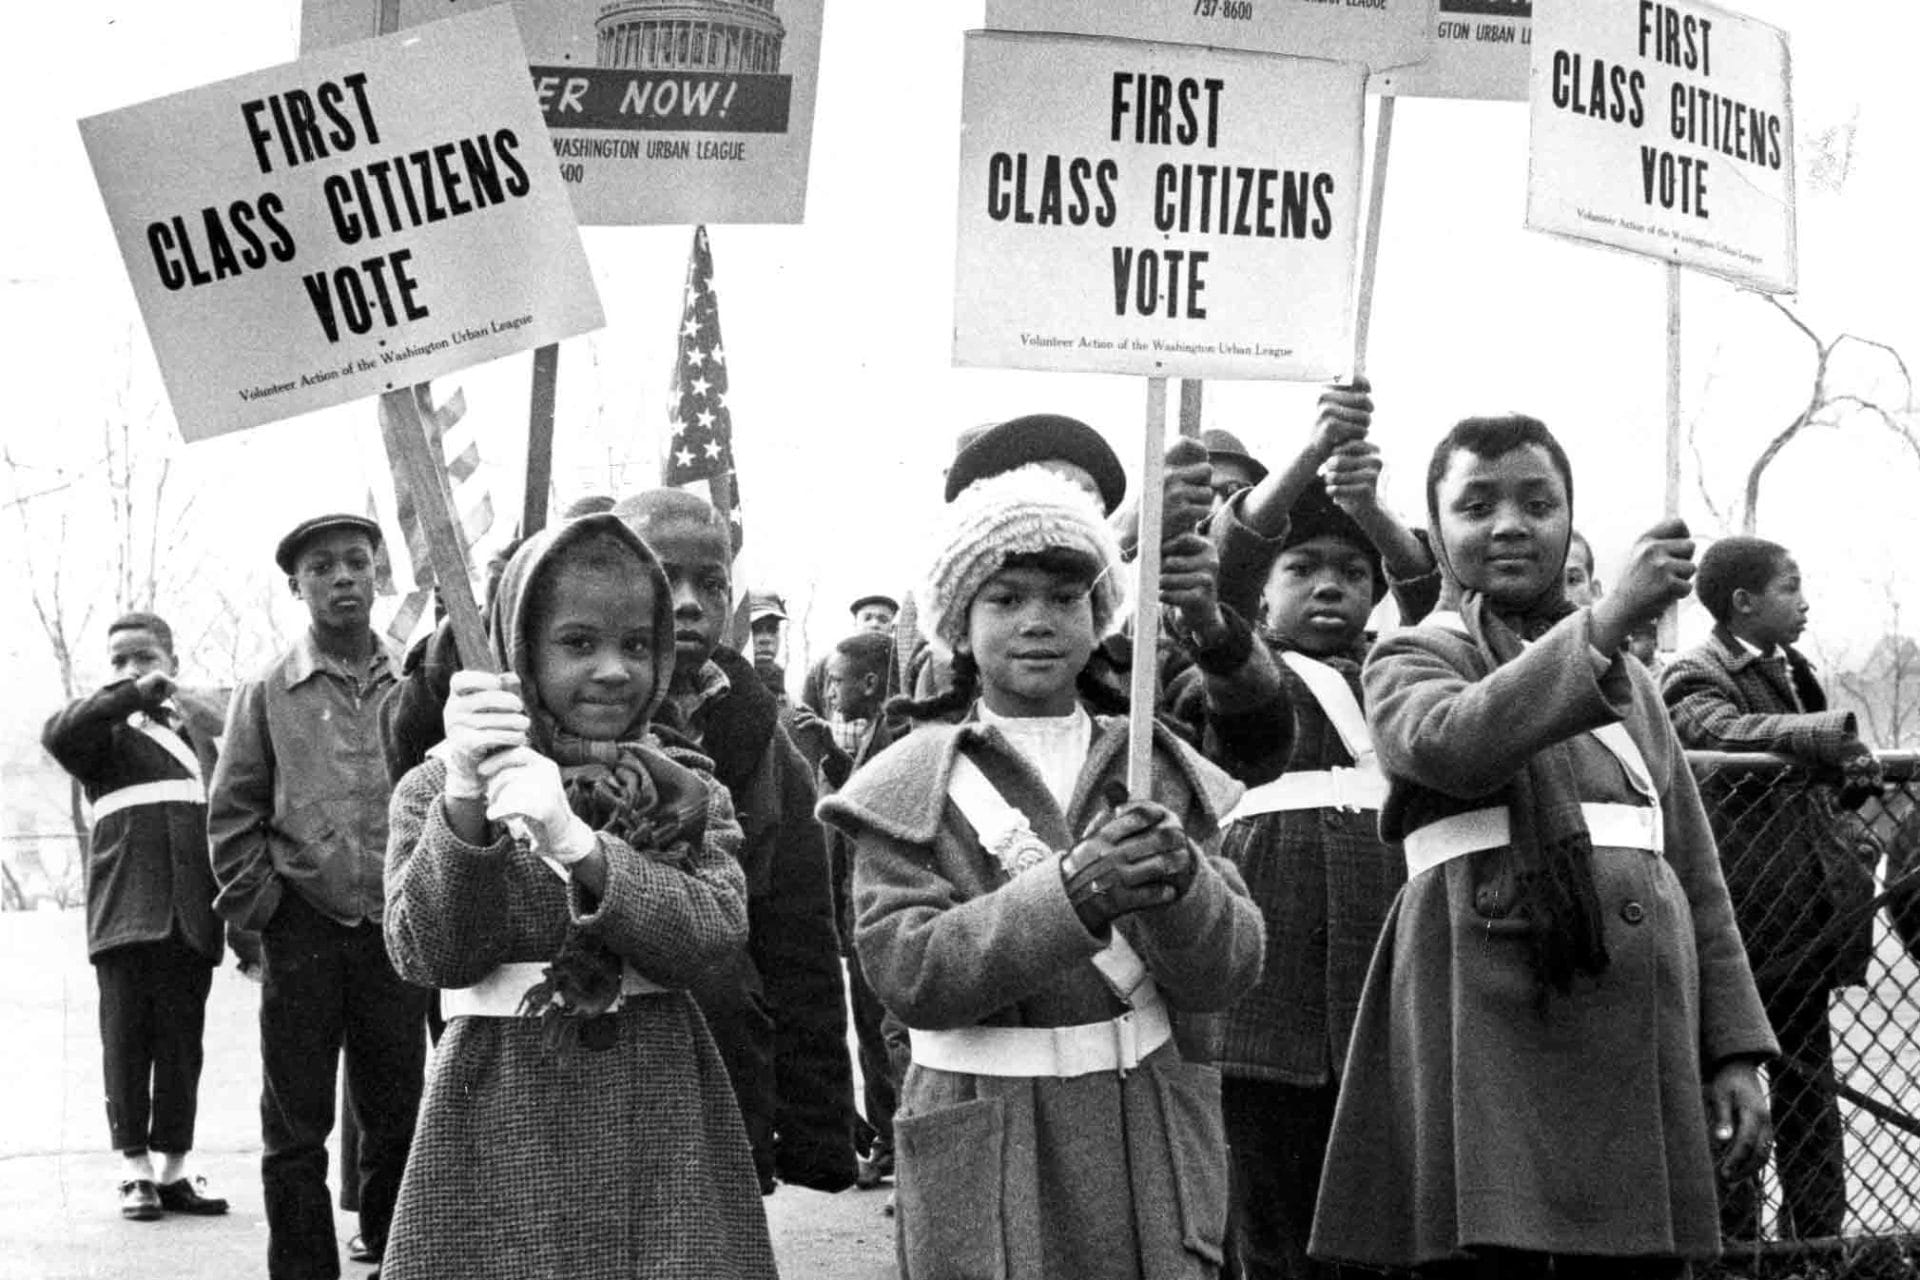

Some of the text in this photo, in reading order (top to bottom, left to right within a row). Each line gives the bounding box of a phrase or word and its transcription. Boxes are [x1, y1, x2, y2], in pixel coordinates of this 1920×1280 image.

[1476, 23, 1515, 43] URBAN
[1639, 0, 1710, 76] FIRST
[242, 73, 379, 173] FIRST
[538, 76, 738, 119] ER NOW!
[1112, 72, 1223, 148] FIRST
[1553, 50, 1780, 169] CLASS CITIZENS
[553, 138, 746, 161] WASHINGTON URBAN LEAGUE
[1642, 146, 1708, 218] VOTE
[147, 129, 529, 290] CLASS CITIZENS
[989, 153, 1333, 239] CLASS CITIZENS
[303, 249, 428, 343] VOTE
[1113, 247, 1208, 318] VOTE
[239, 313, 534, 402] Volunteer Action of the Washington Urban League
[1020, 334, 1293, 357] Volunteer Action of the Washington Urban League
